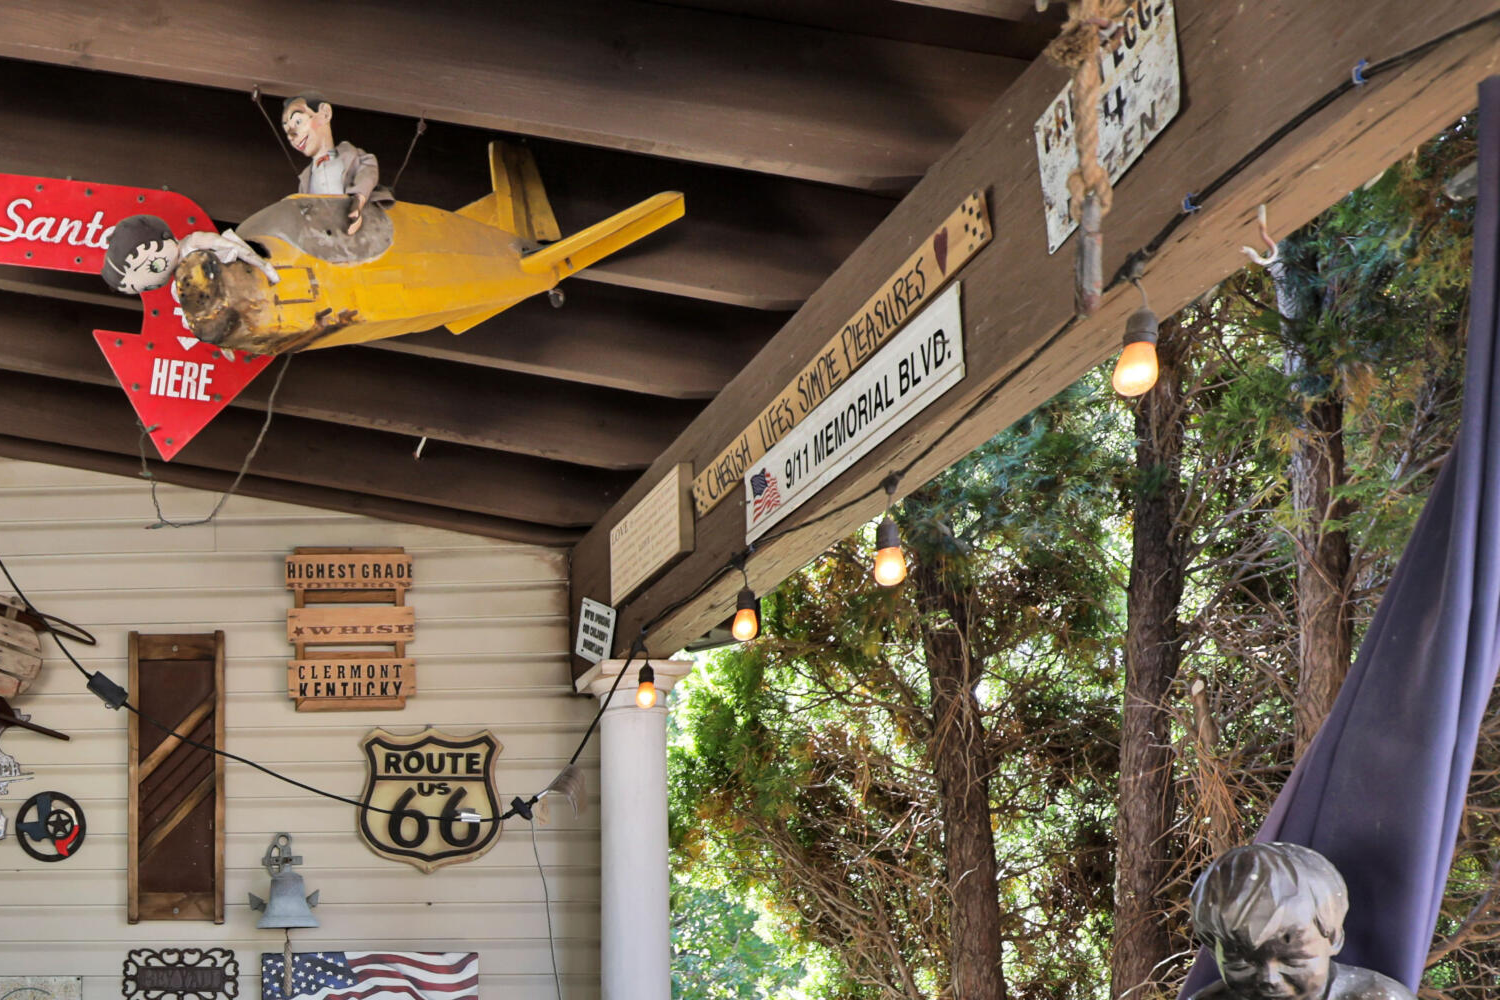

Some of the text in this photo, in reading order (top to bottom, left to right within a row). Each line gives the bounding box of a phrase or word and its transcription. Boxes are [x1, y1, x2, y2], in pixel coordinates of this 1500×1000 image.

[840, 256, 927, 370] PLEASURES
[150, 357, 215, 402] HERE
[784, 328, 953, 490] 9/11 MEMORIAL BLVD.
[612, 519, 629, 545] LOVE
[287, 562, 413, 579] HIGHEST GRADE
[298, 664, 403, 680] CLERMONT
[299, 681, 403, 697] KENTUCKY
[384, 750, 482, 774] ROUTE
[417, 782, 451, 796] US
[388, 787, 480, 848] 66
